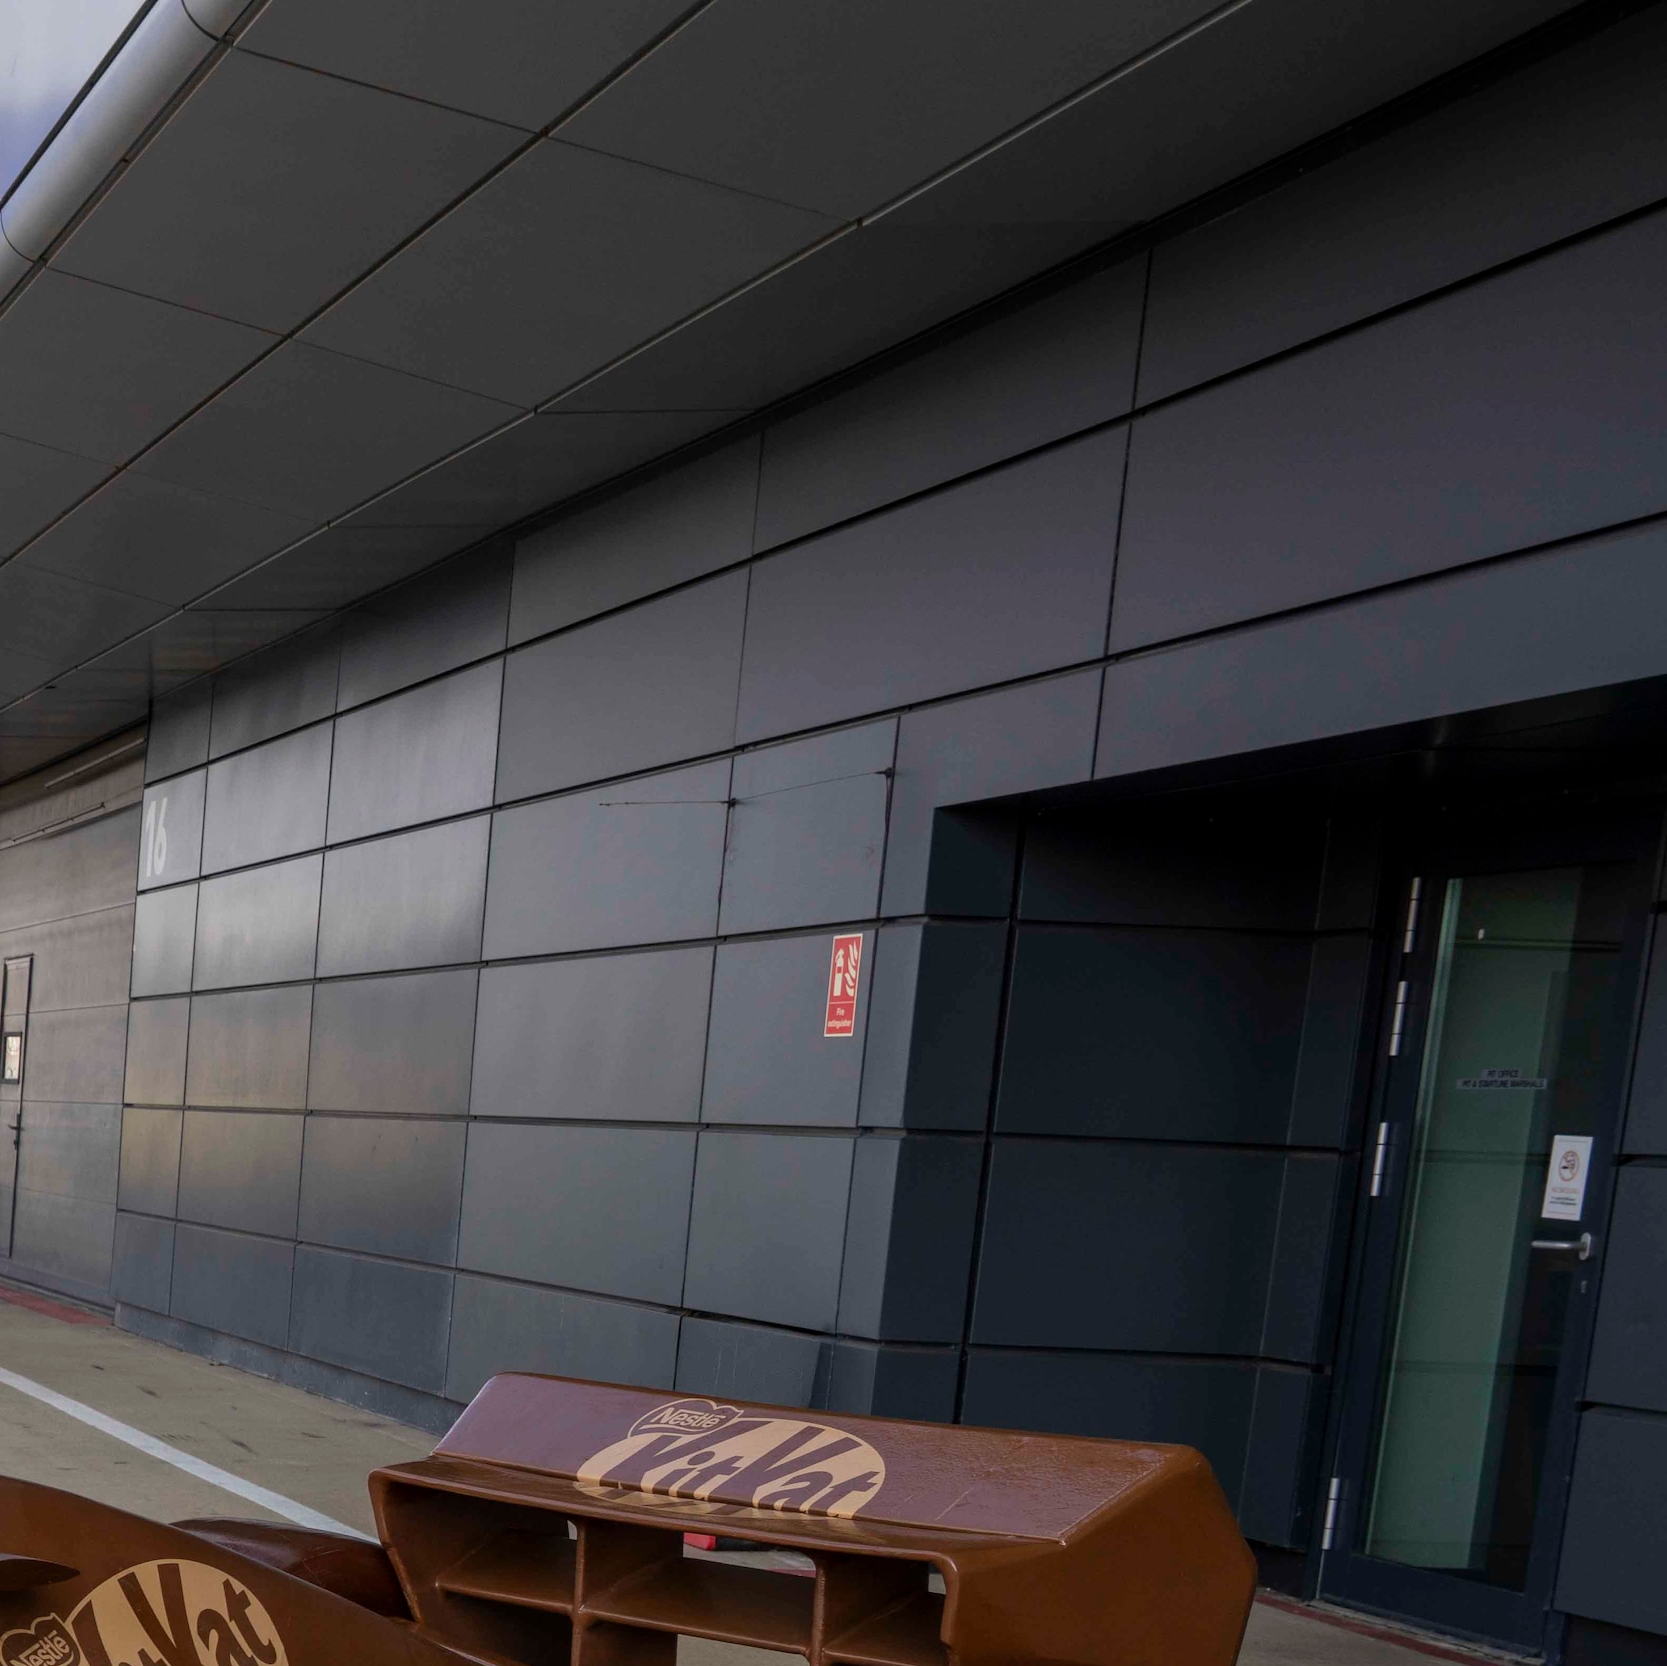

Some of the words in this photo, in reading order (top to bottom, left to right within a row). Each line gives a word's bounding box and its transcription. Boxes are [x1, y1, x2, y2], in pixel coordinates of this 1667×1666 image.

[145, 796, 168, 877] 16
[836, 1007, 845, 1017] Fire
[649, 1406, 726, 1431] Nestlé
[595, 1419, 882, 1518] KitKat
